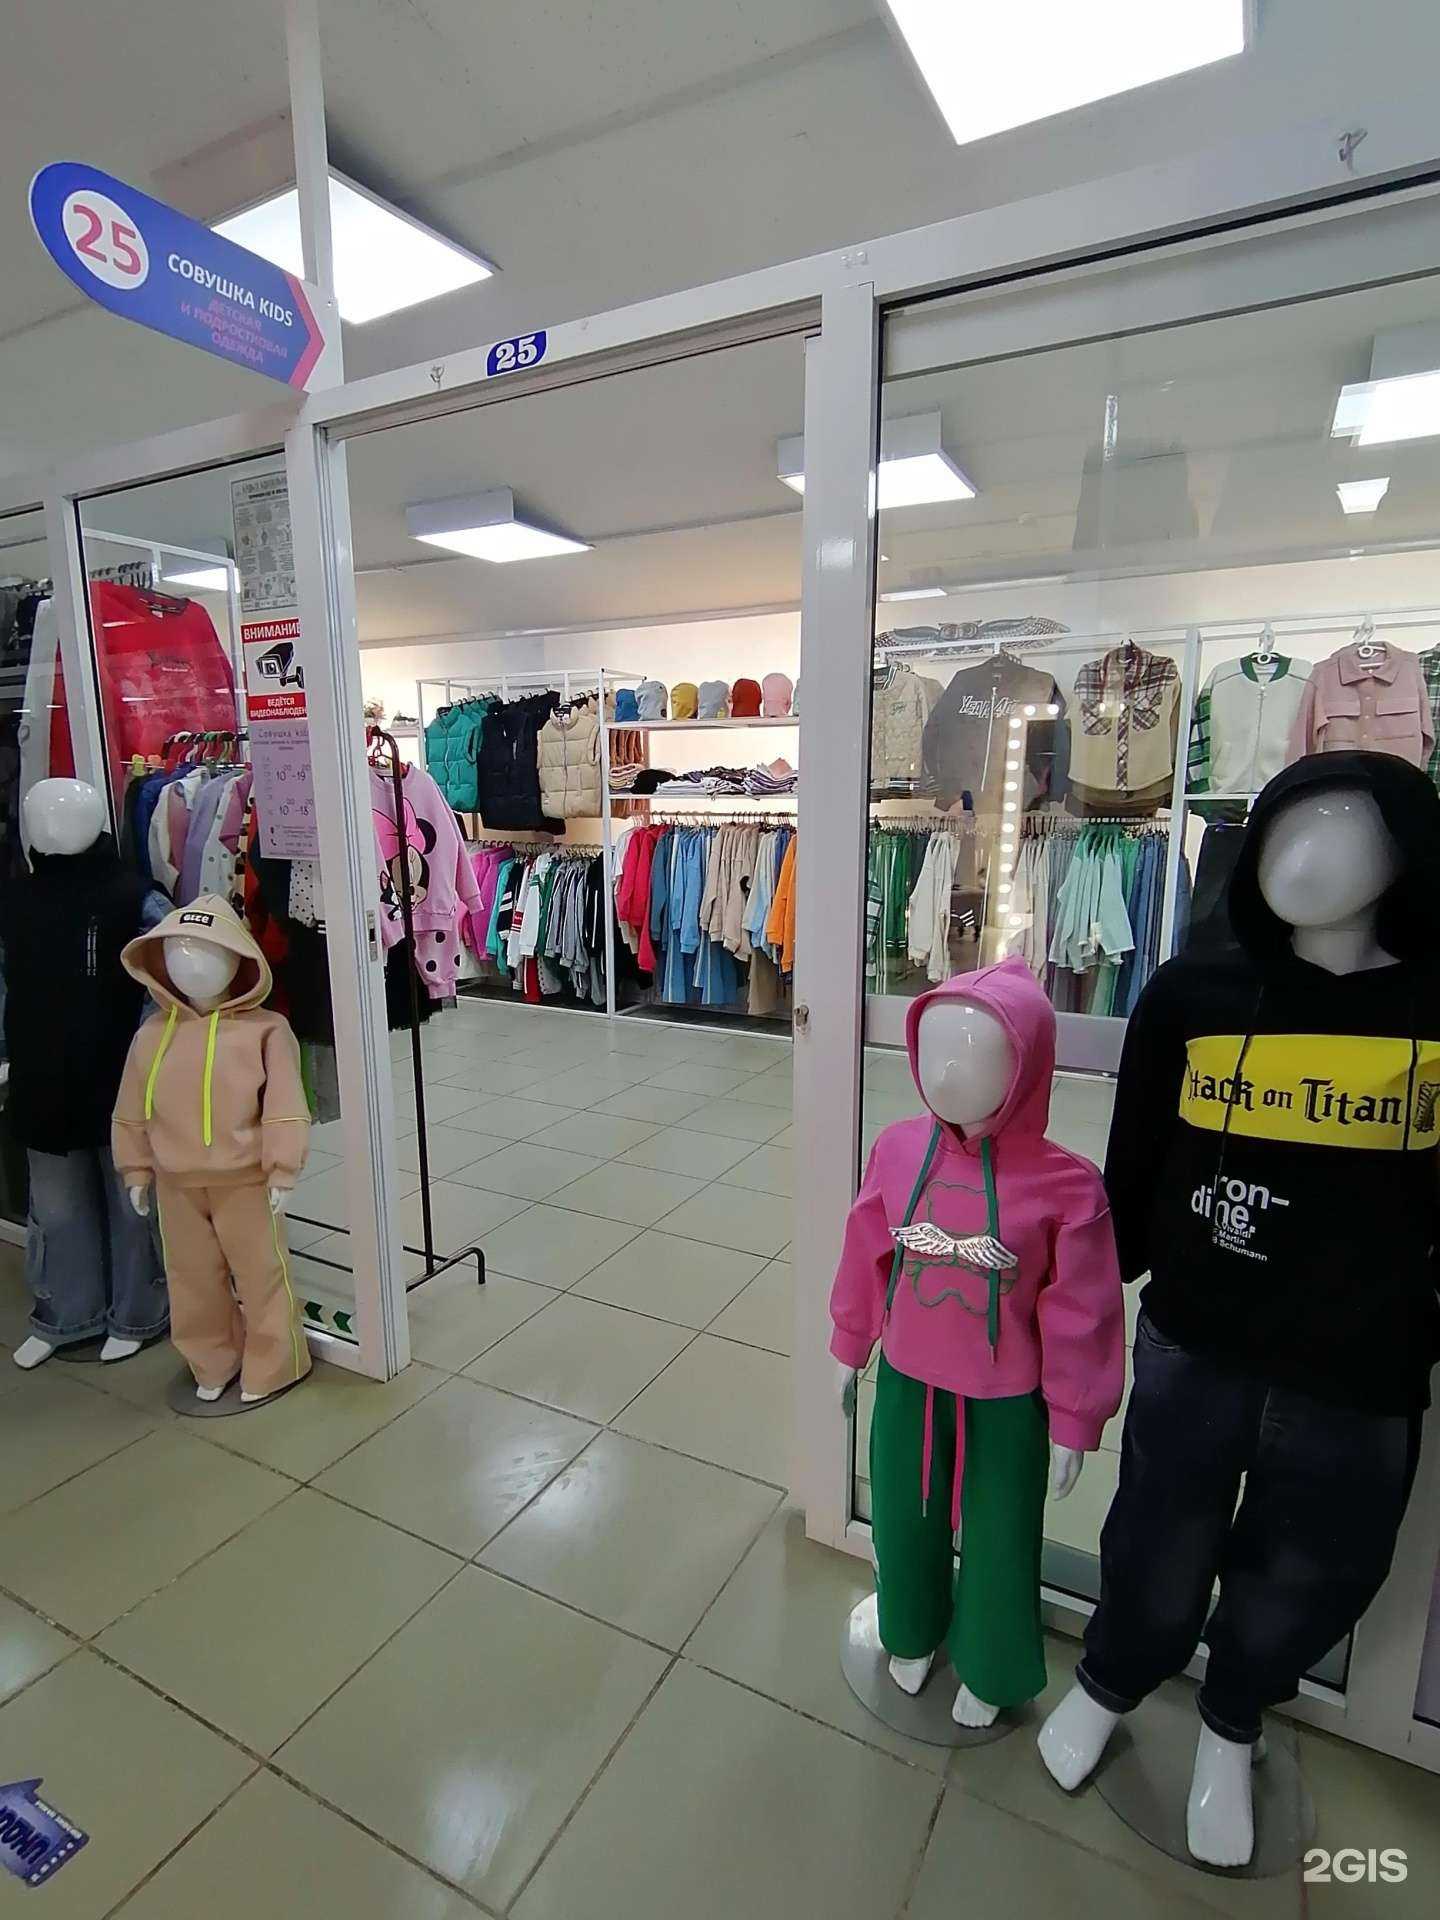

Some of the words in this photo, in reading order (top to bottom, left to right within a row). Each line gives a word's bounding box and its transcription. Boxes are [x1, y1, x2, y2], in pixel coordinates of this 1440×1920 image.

[73, 204, 141, 275] 25
[168, 254, 255, 309] СОВУШКА
[260, 298, 293, 327] KIDS
[496, 336, 537, 370] 25
[244, 622, 300, 640] ВНИМАНИЕ
[1262, 1088, 1293, 1109] on
[1299, 1077, 1402, 1125] Titan
[1219, 1230, 1245, 1246] Martin
[1219, 1239, 1268, 1262] Schumann
